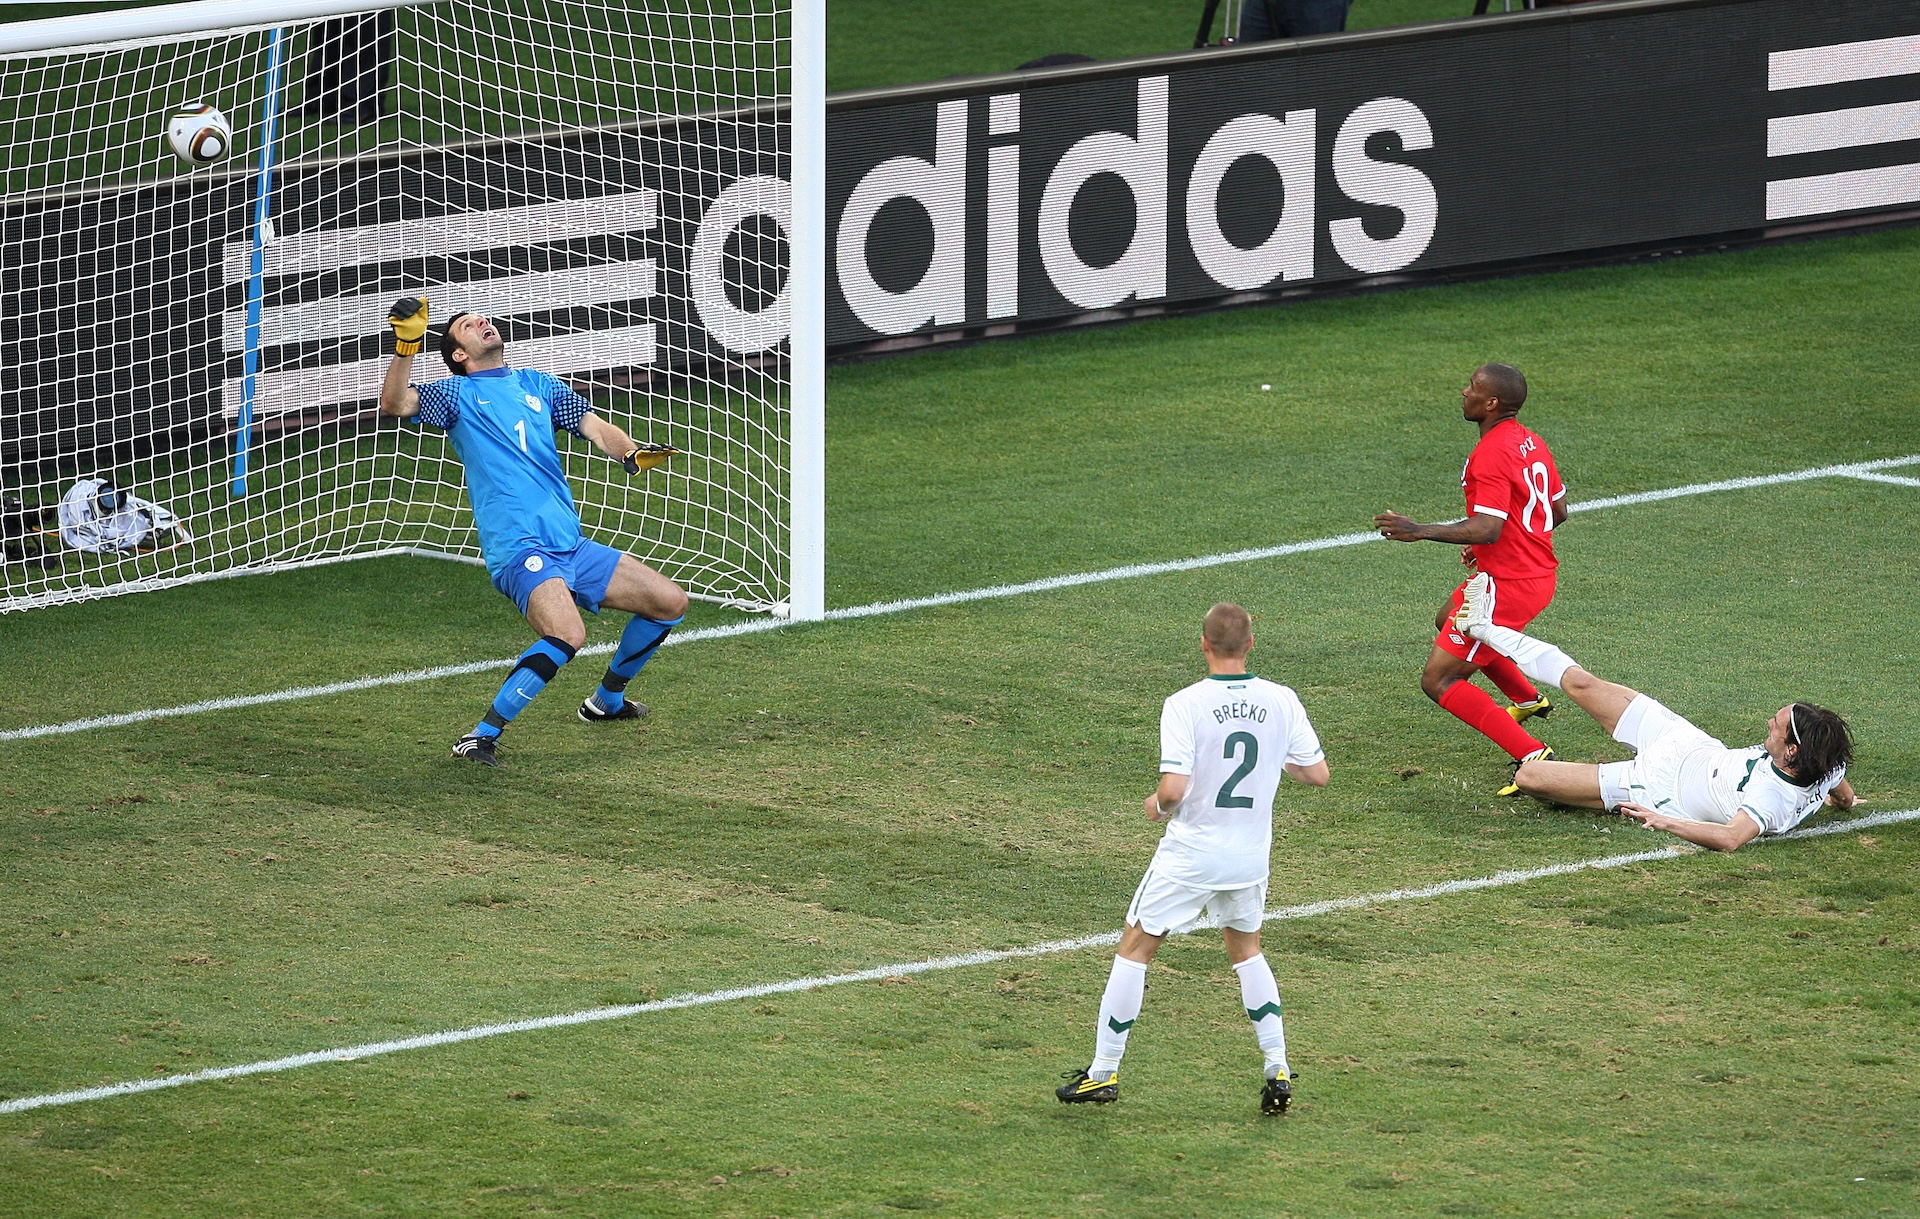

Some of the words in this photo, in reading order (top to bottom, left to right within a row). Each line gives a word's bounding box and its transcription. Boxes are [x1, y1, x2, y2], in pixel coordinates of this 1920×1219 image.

[689, 75, 1438, 354] adidas
[513, 419, 528, 452] 1
[1522, 461, 1554, 533] 19
[1213, 698, 1267, 725] BREČKO
[1215, 731, 1259, 809] 2
